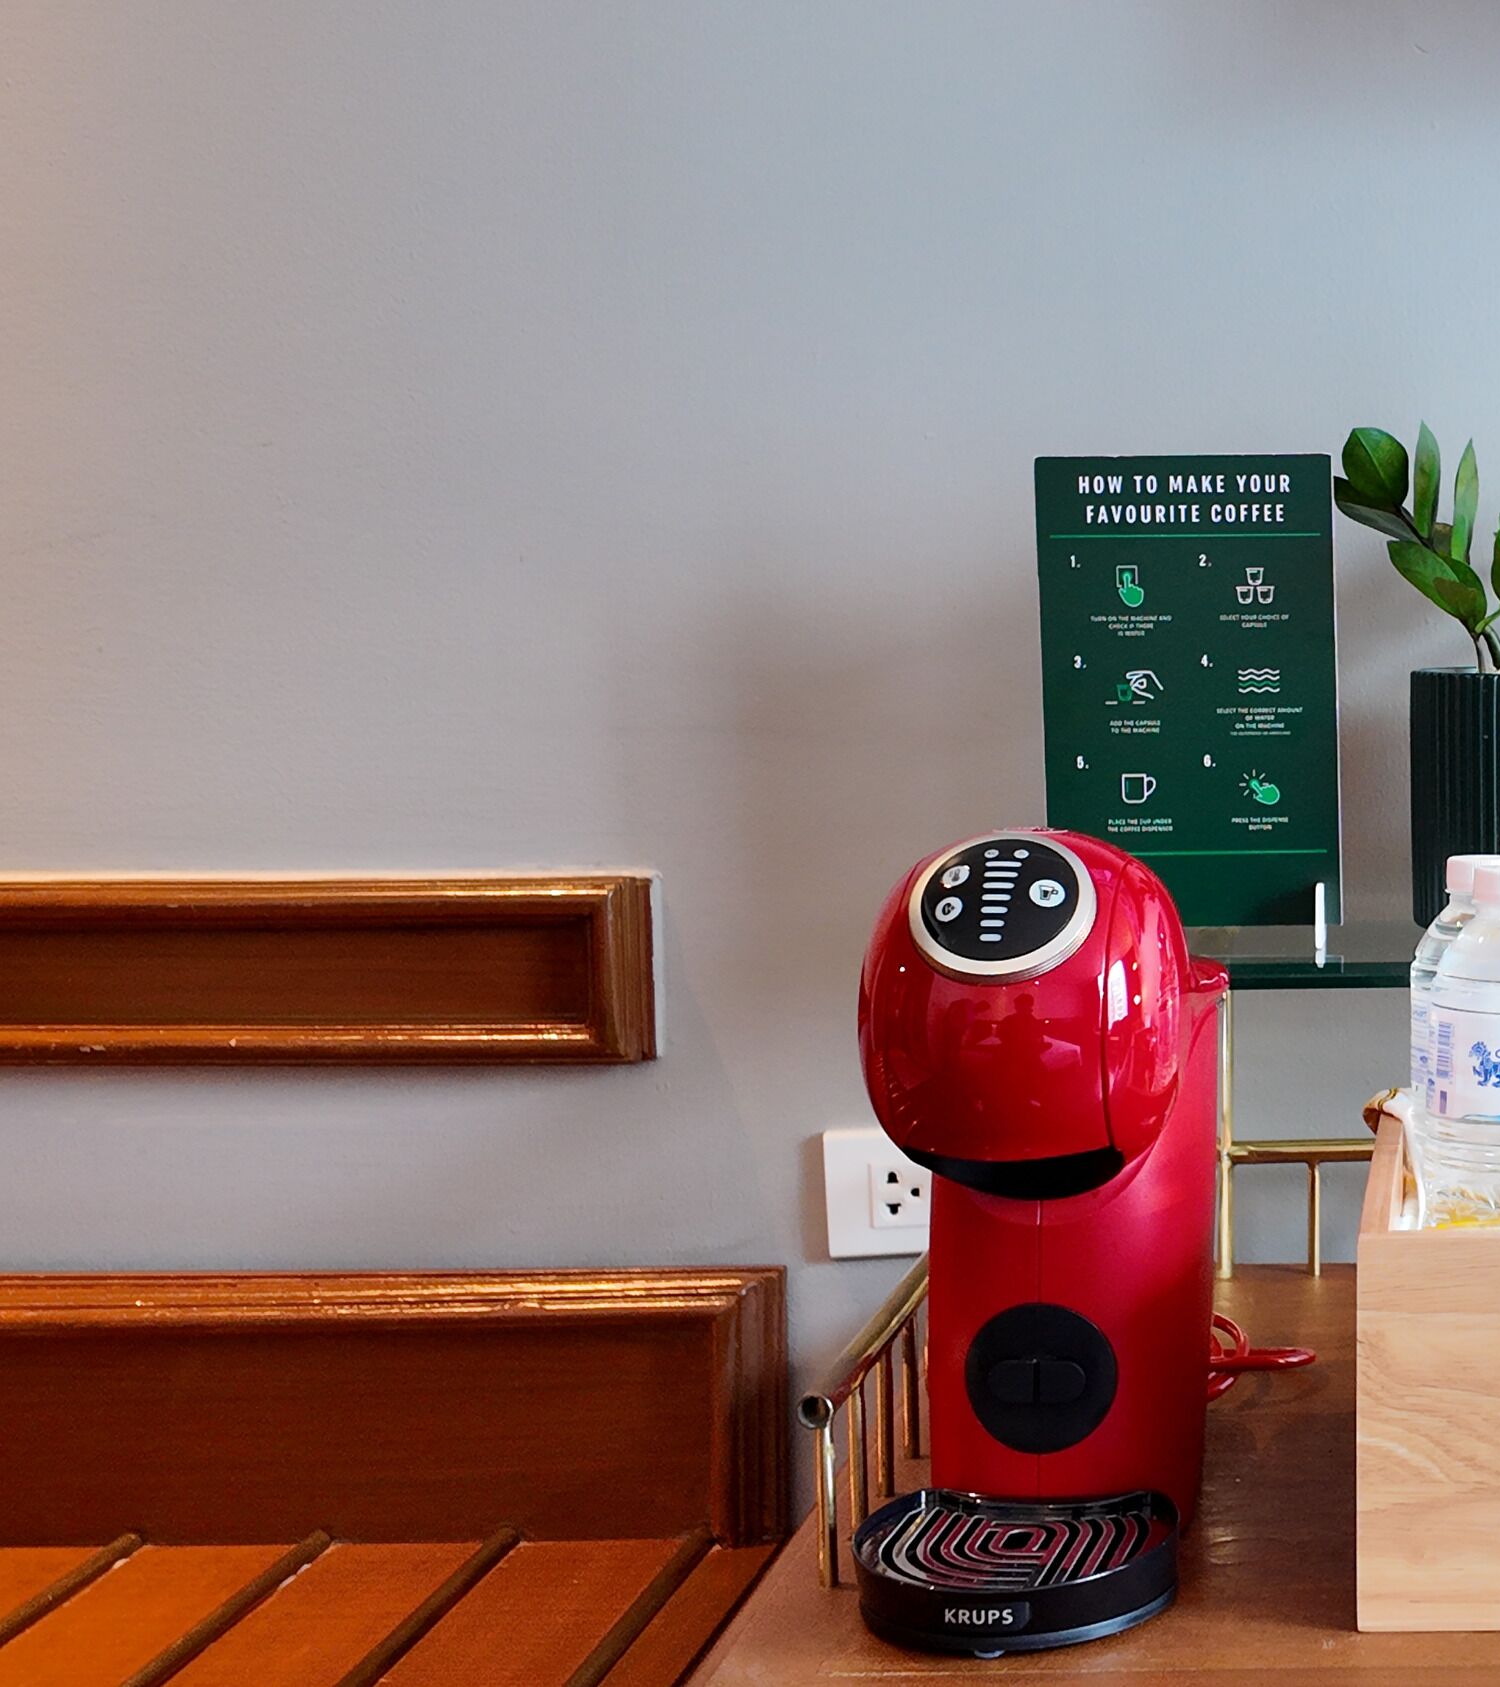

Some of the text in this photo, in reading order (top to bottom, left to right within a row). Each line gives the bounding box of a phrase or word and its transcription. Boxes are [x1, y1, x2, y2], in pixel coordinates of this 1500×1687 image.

[1078, 474, 1291, 494] HOW TO MAKE YOUR
[1086, 504, 1285, 524] FAVOURITE COFFEE
[1070, 555, 1081, 568] 1.
[1199, 554, 1212, 567] 2.
[1074, 655, 1087, 669] 3.
[1200, 654, 1213, 668] 4.
[1076, 756, 1089, 769] 5.
[1203, 754, 1216, 768] 6.
[944, 1607, 1014, 1625] KRUPS
